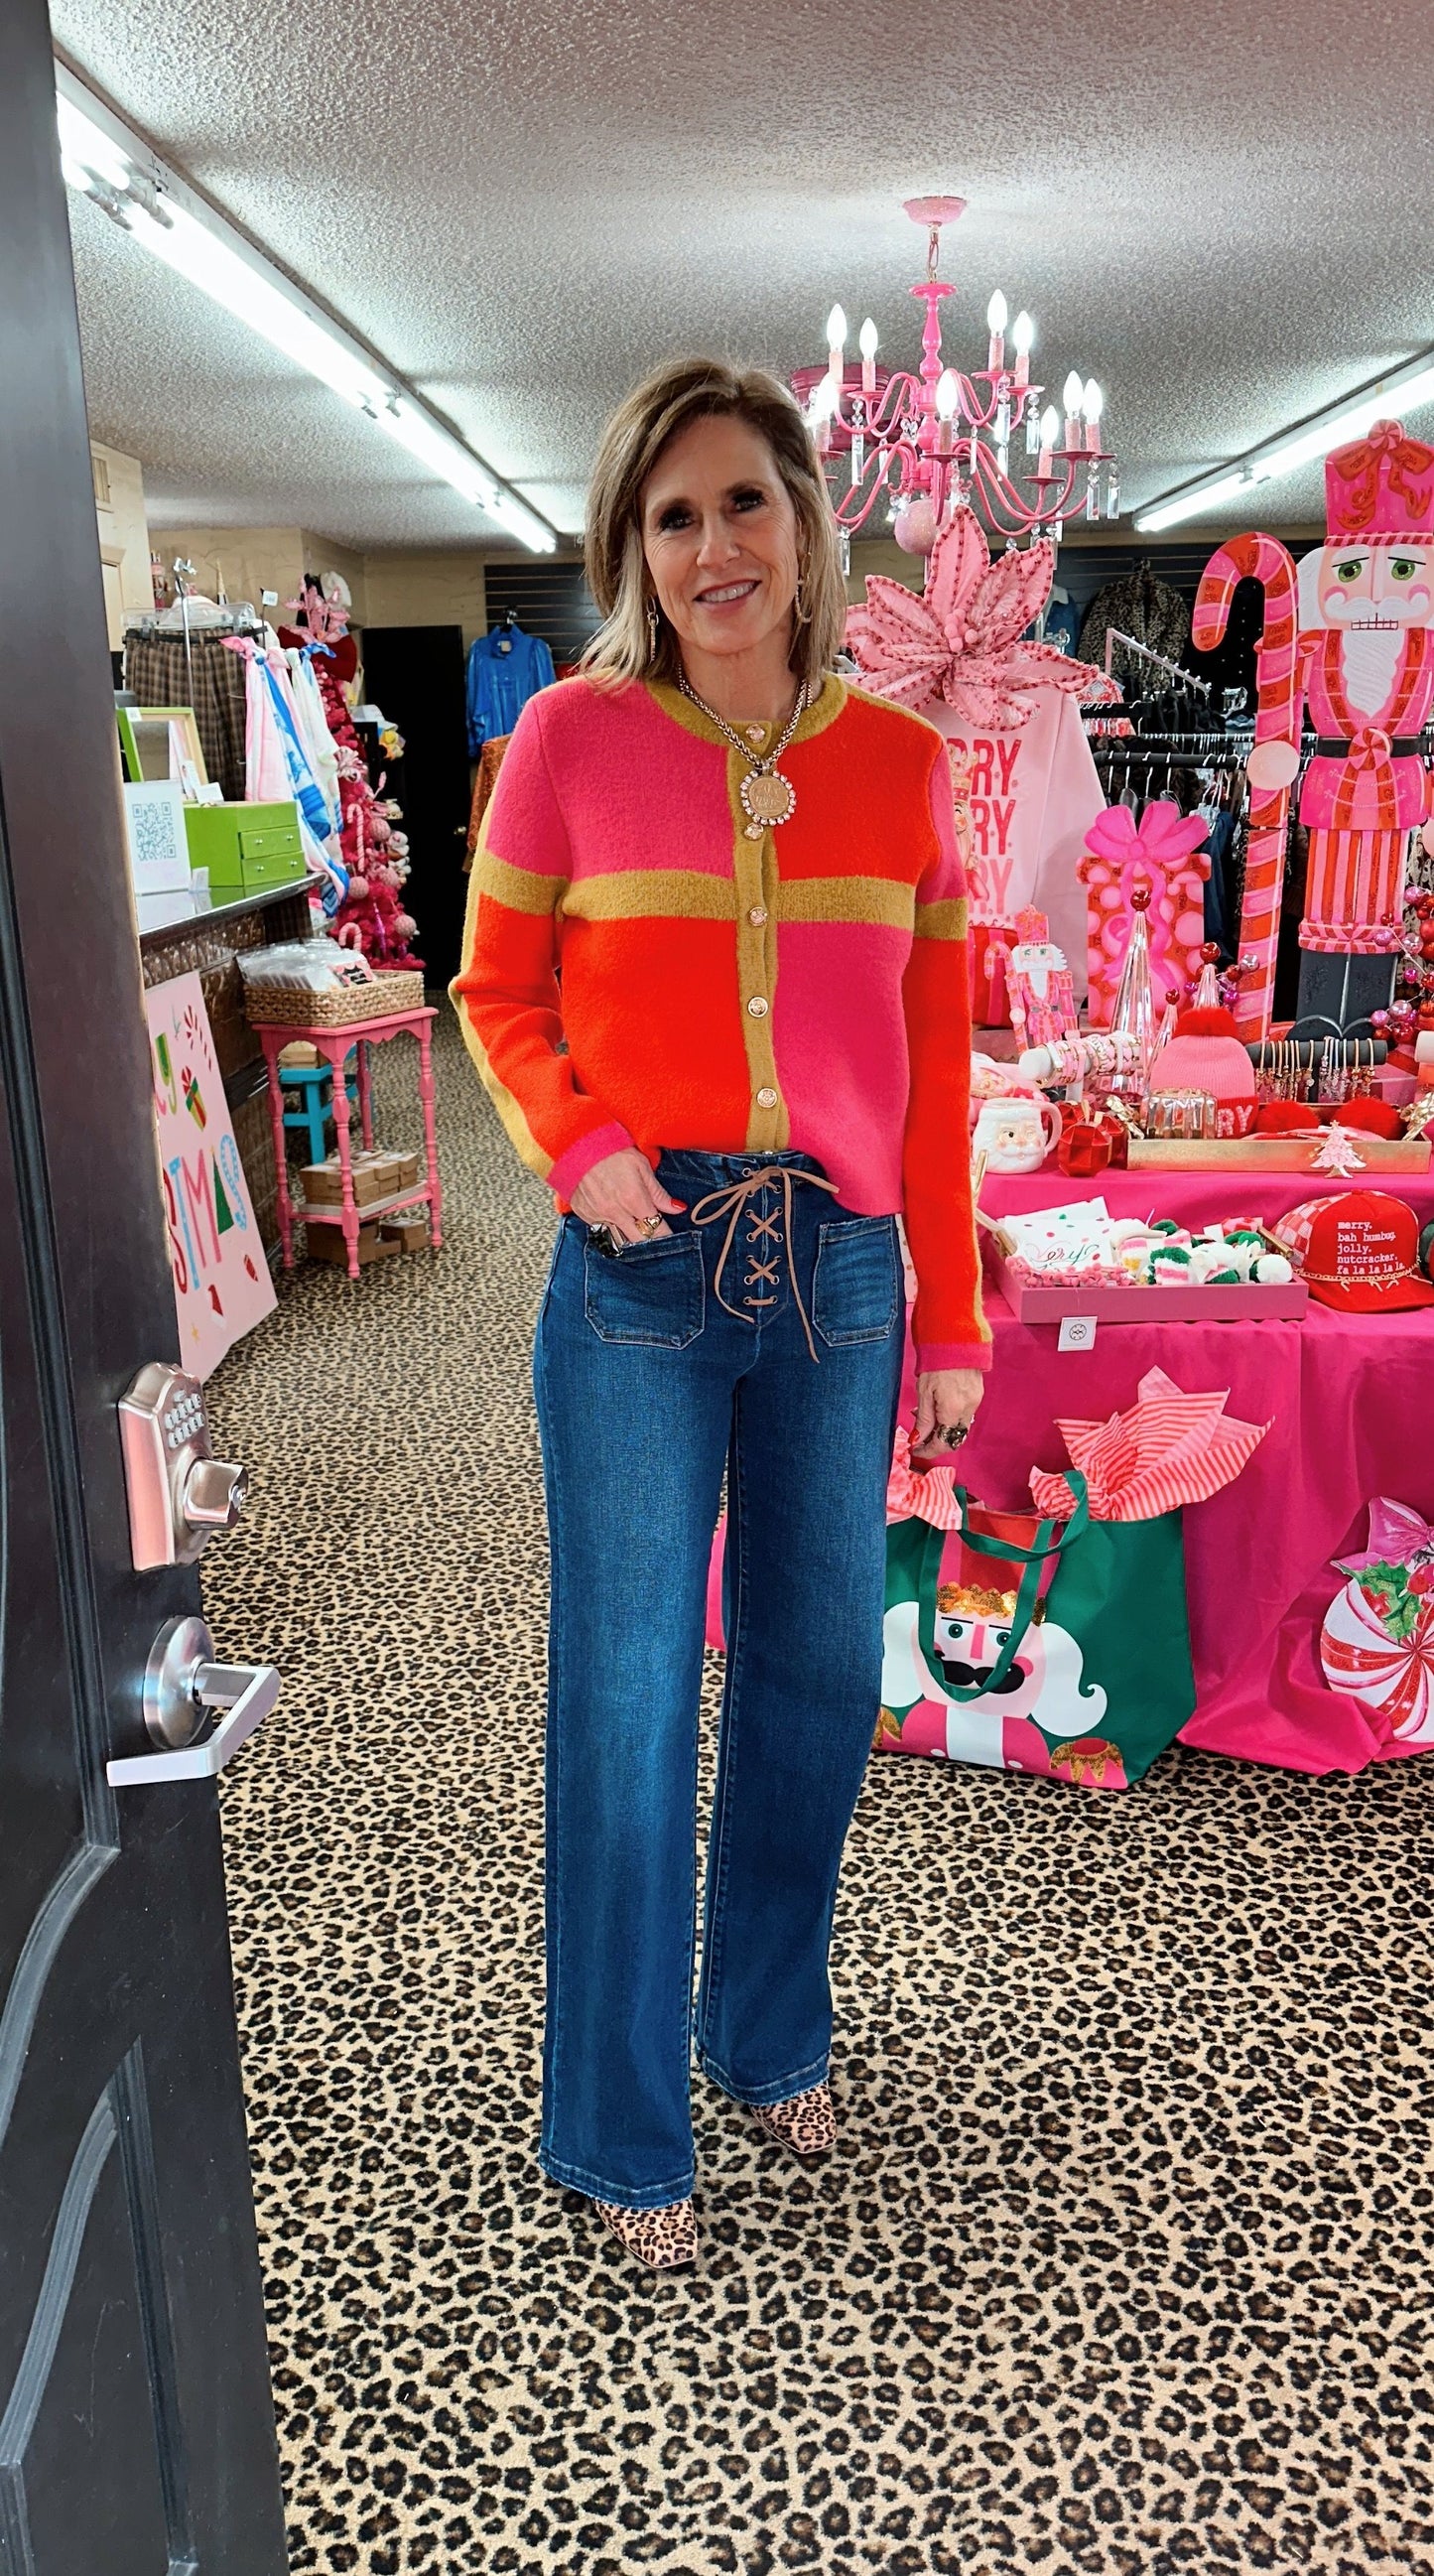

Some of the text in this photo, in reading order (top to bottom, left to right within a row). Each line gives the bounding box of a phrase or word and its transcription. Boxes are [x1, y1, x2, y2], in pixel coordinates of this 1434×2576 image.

[1337, 1221, 1372, 1232] merry.
[1337, 1232, 1358, 1242] bah
[1337, 1243, 1372, 1255] jolly.
[1337, 1253, 1398, 1264] nutcracker.
[1337, 1265, 1350, 1276] fa
[1353, 1265, 1366, 1276] la
[1369, 1265, 1380, 1275] la
[1382, 1263, 1393, 1274] la
